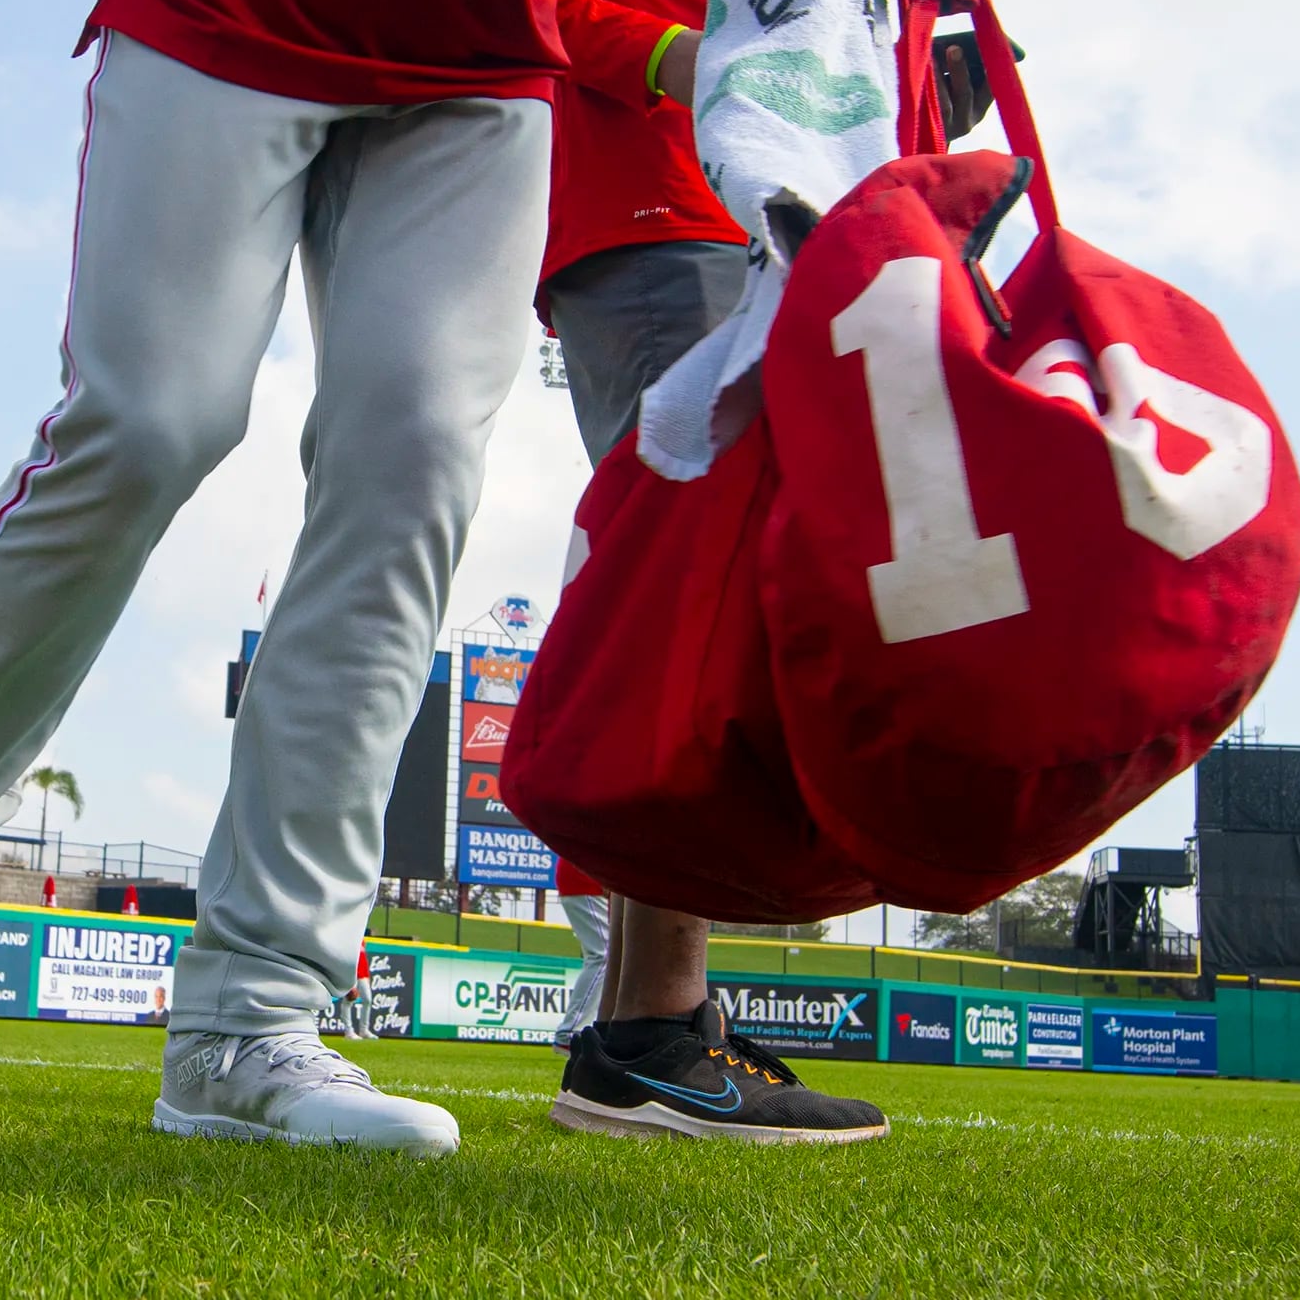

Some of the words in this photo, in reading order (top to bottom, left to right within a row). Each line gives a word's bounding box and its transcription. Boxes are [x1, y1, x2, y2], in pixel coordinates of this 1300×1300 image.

[634, 207, 670, 218] DRI-FIT
[469, 831, 552, 852] BANQUE
[469, 849, 552, 869] MASTERS
[472, 867, 549, 881] banquetmasters.com
[48, 926, 171, 965] INJURED?
[51, 962, 71, 975] CALL
[73, 965, 115, 978] MAGAZINE
[116, 967, 134, 979] LAW
[135, 969, 163, 981] GROUP
[370, 956, 390, 972] Eat.
[371, 971, 405, 990] Drink.
[71, 986, 148, 1005] 727-499-9900
[371, 993, 399, 1013] Stay
[456, 980, 574, 1013] CP-RANKI
[715, 988, 866, 1027] MaintenX
[457, 1026, 518, 1040] ROOFING
[522, 1028, 556, 1042] EXPE
[732, 1024, 754, 1035] Total
[756, 1025, 795, 1036] Facilities
[797, 1027, 827, 1039] Repair
[839, 1030, 872, 1041] Experts
[911, 1020, 950, 1040] Fanatics
[966, 1007, 1018, 1045] Times
[1033, 1029, 1077, 1040] CONSTRUCTION
[1123, 1027, 1170, 1039] Morton
[1172, 1028, 1205, 1041] Plant
[1123, 1040, 1175, 1054] Hospital
[1124, 1054, 1153, 1064] BayCare
[1154, 1055, 1175, 1063] Health
[1176, 1056, 1200, 1065] System
